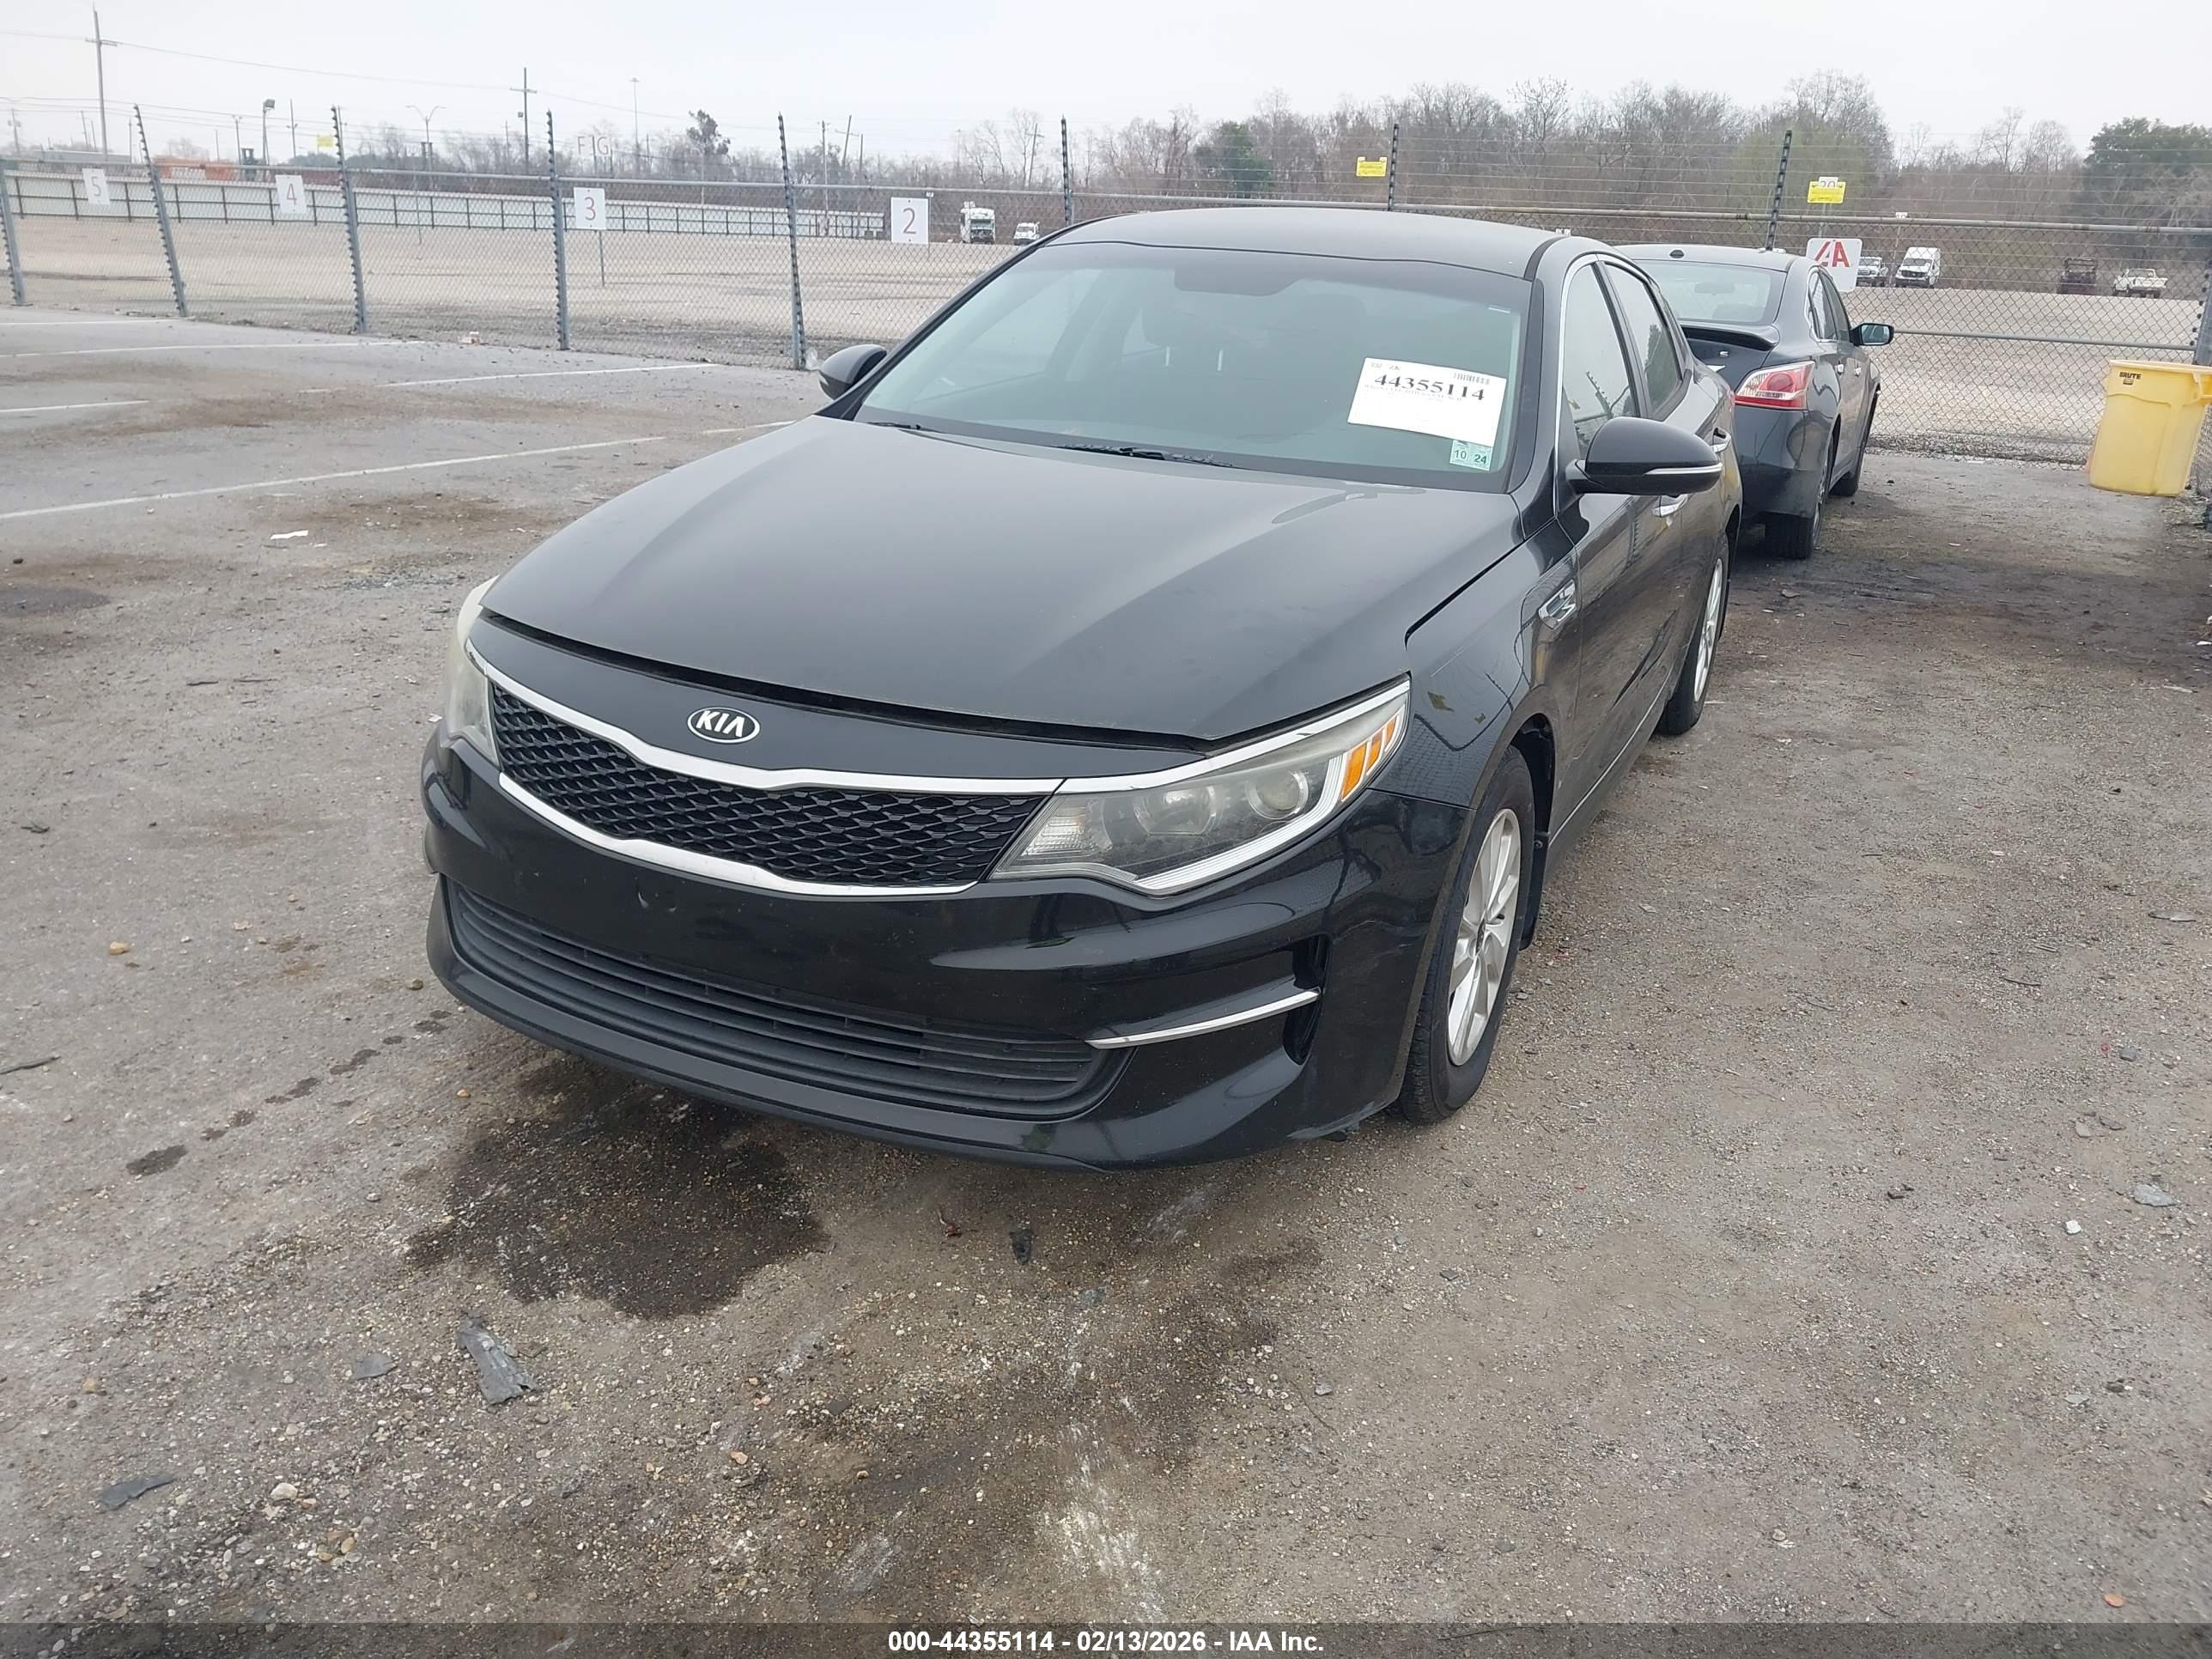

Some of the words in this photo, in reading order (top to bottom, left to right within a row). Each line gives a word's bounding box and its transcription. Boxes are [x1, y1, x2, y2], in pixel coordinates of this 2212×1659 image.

[90, 176, 101, 197] 5
[287, 183, 297, 206] 4
[584, 196, 596, 221] 3
[902, 207, 917, 234] 2
[1374, 374, 1485, 401] 44355114
[2118, 371, 2142, 380] BRUTE
[1454, 449, 1467, 459] 10
[1474, 453, 1487, 465] 24
[696, 710, 745, 738] KIA
